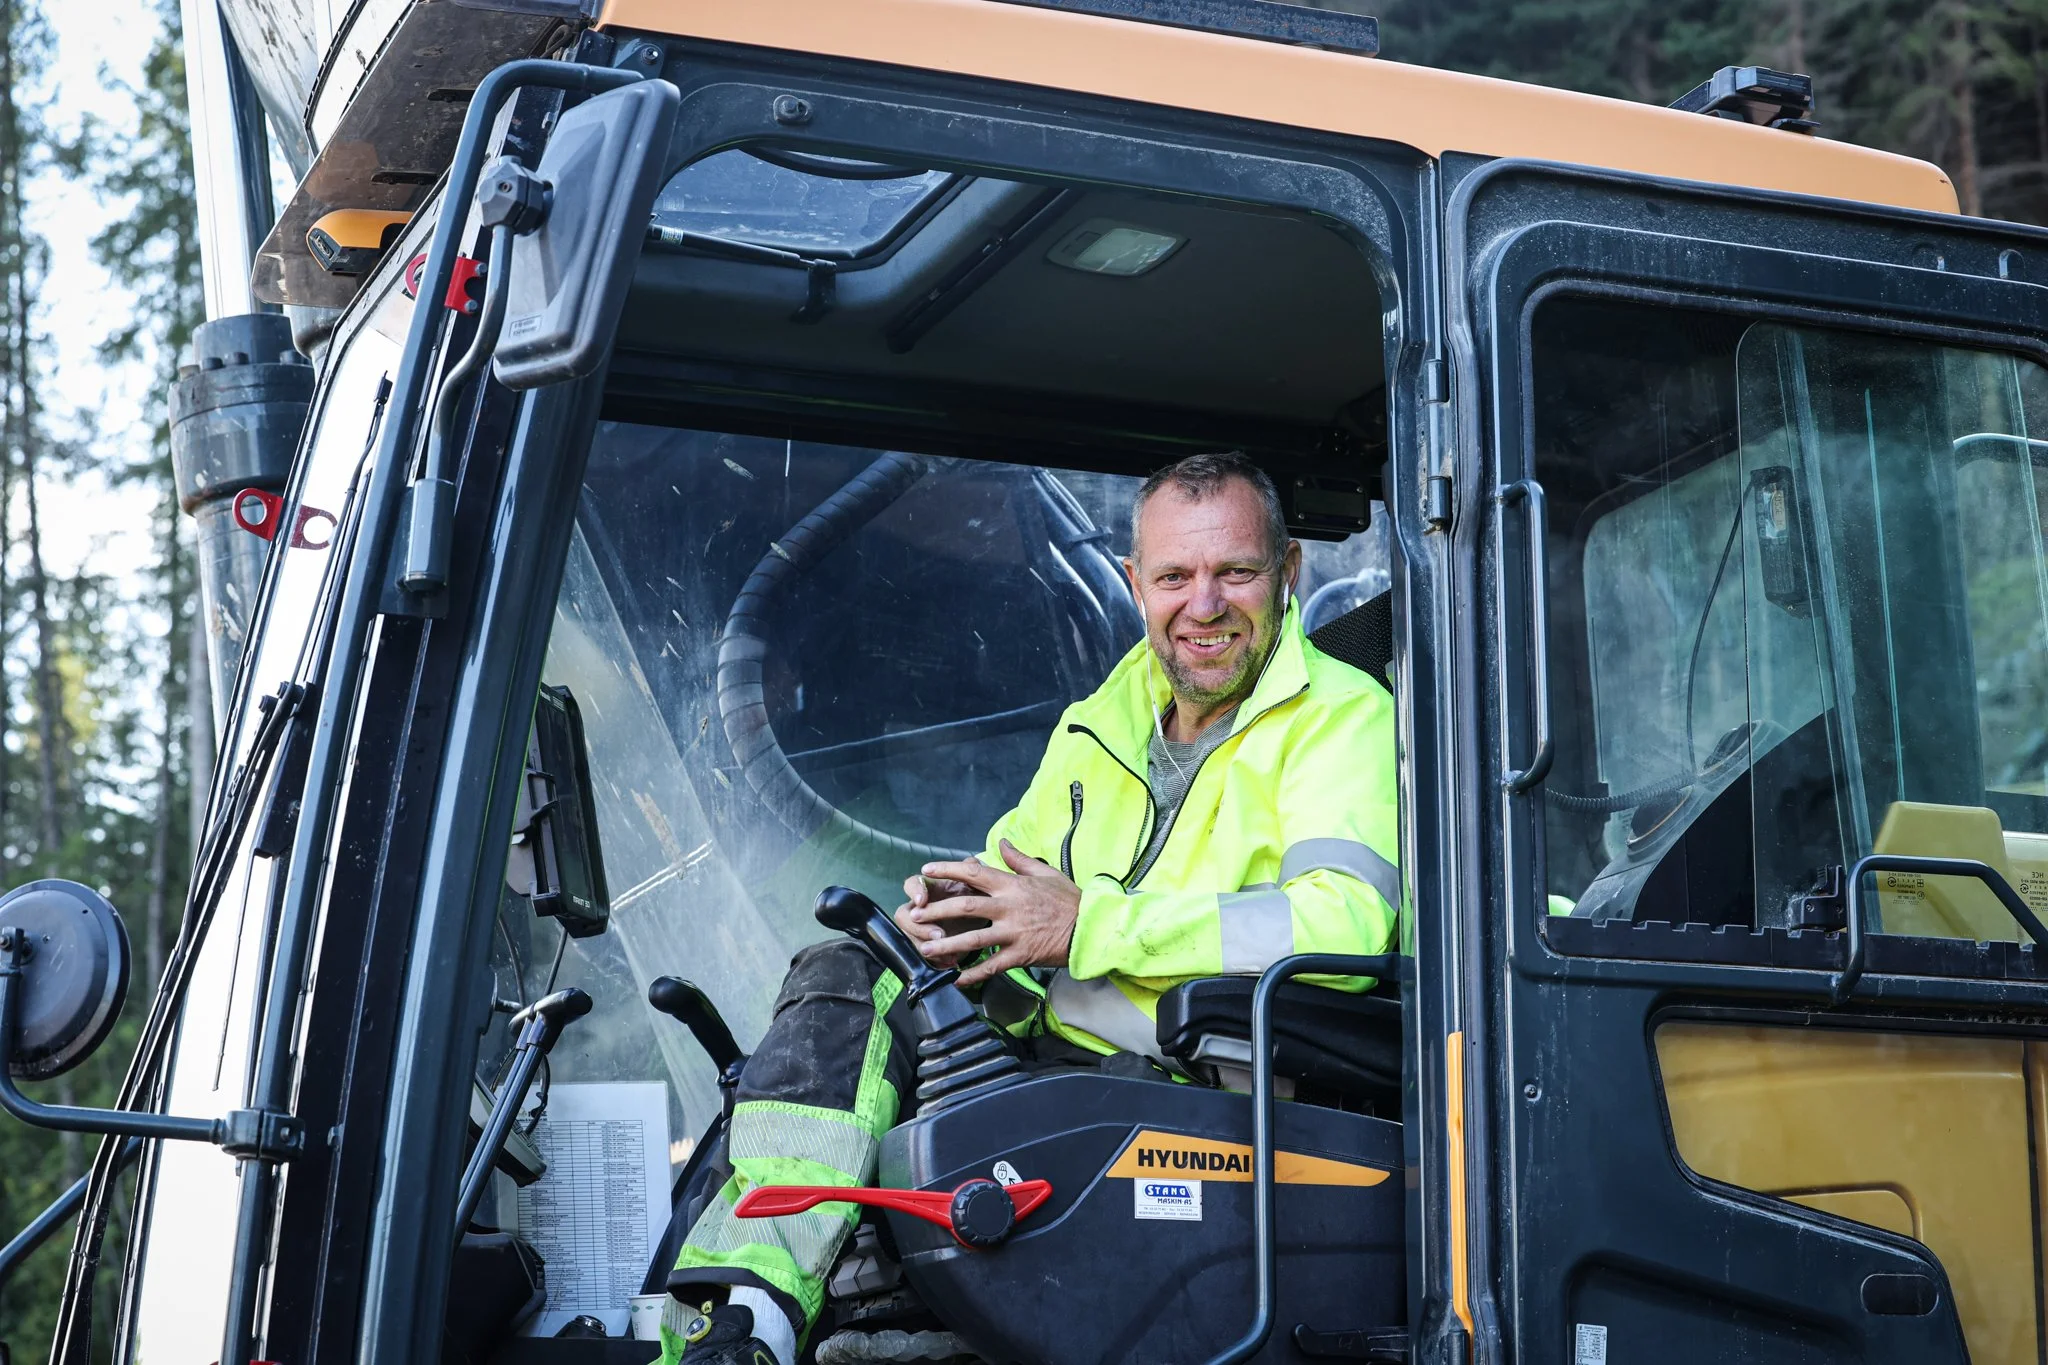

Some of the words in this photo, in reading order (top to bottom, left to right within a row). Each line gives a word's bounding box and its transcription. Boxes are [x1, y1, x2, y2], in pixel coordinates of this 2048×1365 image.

[1138, 1148, 1250, 1173] HYUNDAI
[1147, 1185, 1186, 1196] STANG
[1157, 1197, 1182, 1205] MASKIN
